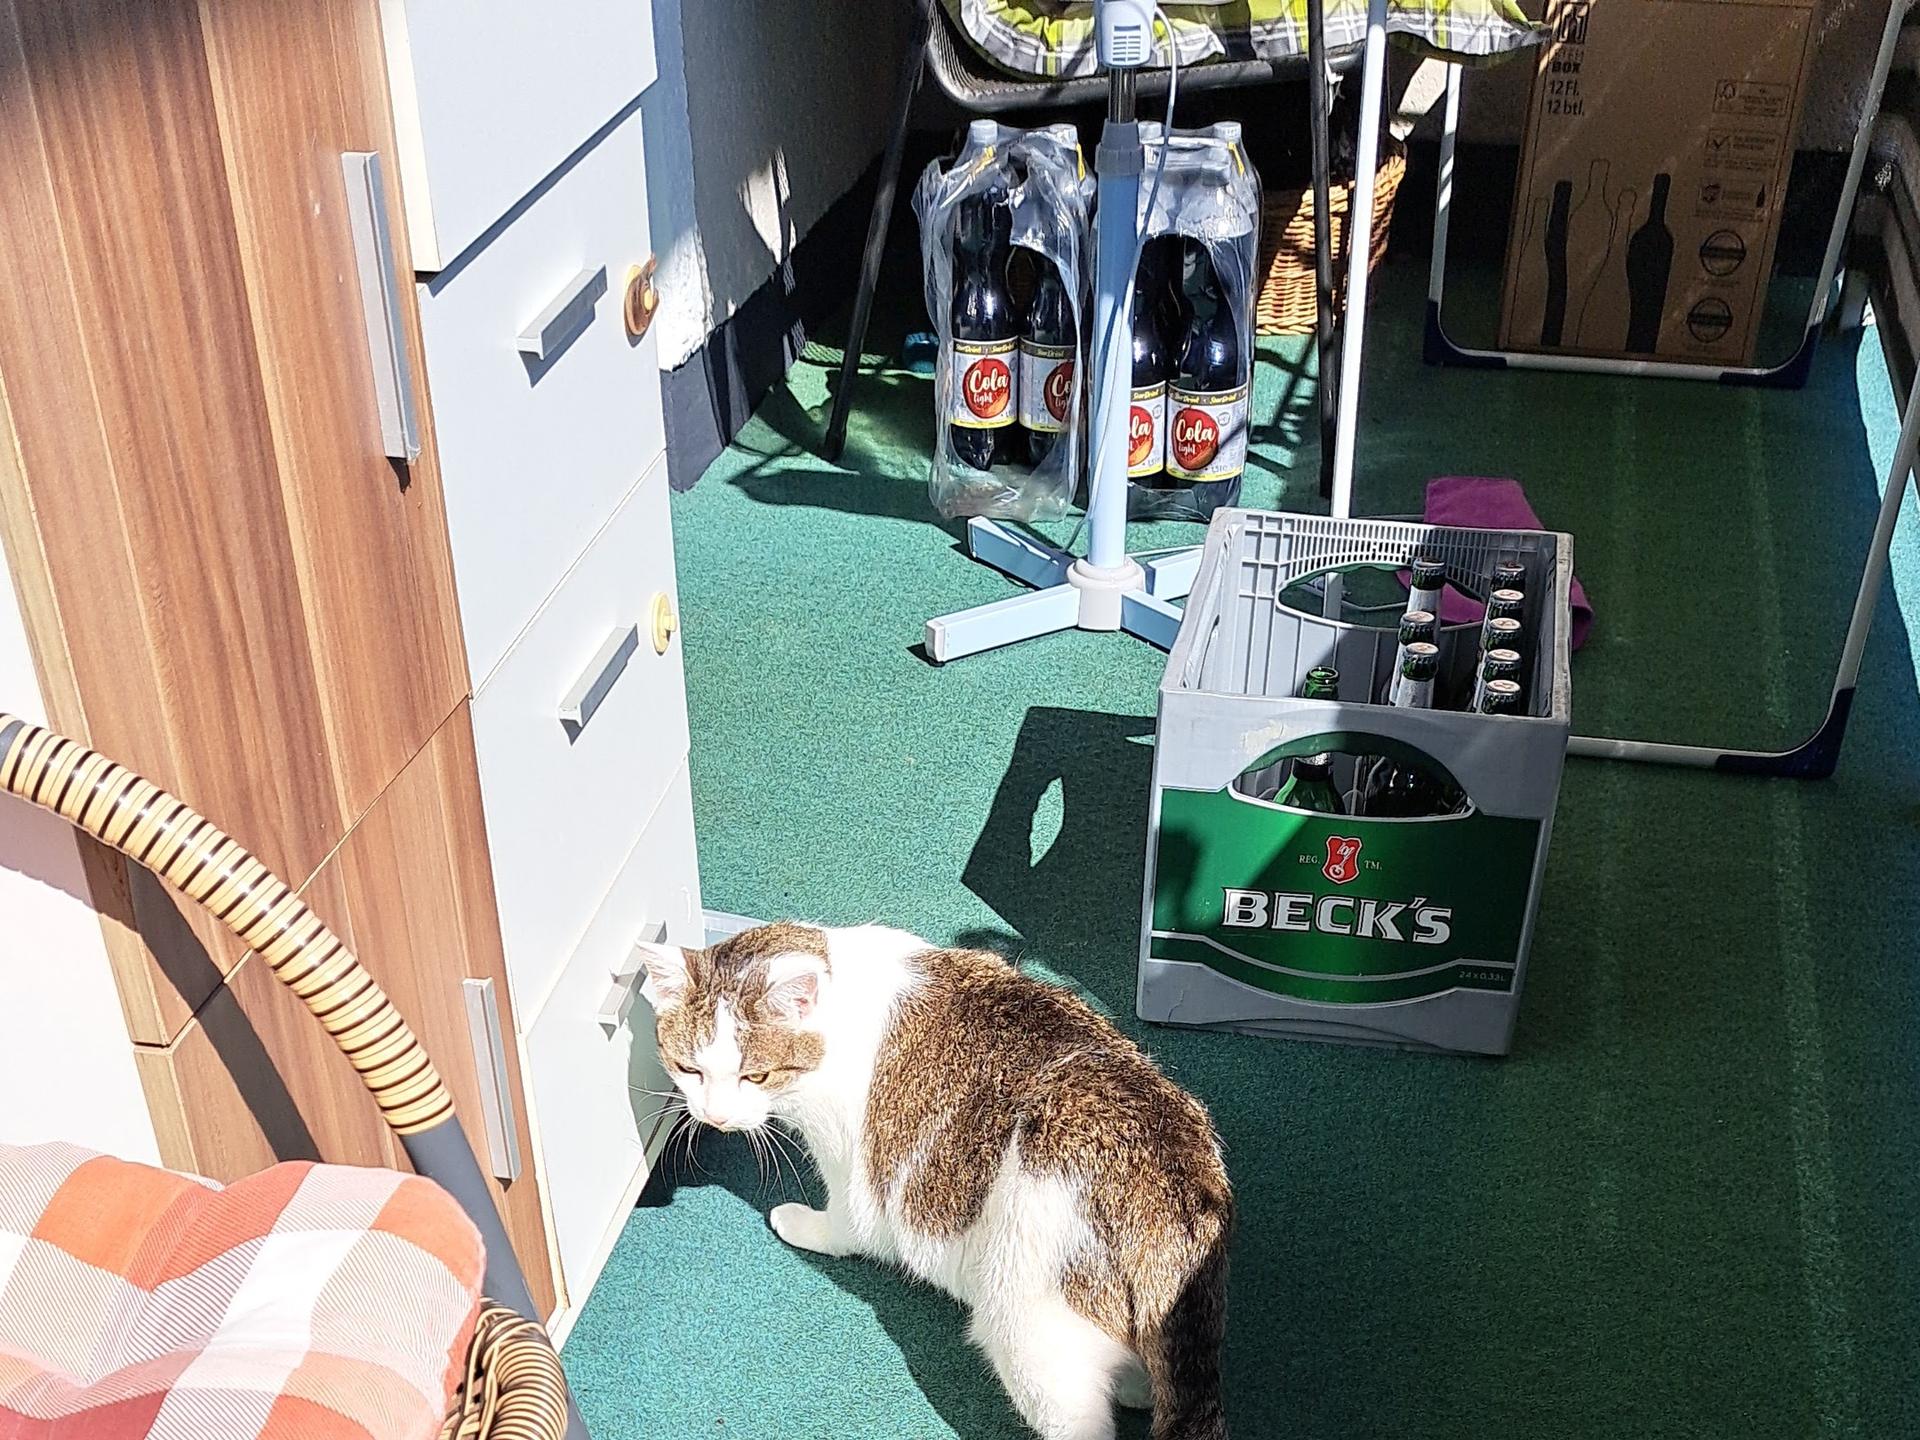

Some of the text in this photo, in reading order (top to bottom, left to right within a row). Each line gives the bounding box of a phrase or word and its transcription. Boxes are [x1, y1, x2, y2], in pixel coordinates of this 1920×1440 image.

[969, 368, 1008, 393] Cola
[1052, 374, 1071, 397] Co
[974, 392, 993, 406] light
[1131, 416, 1151, 439] la
[1176, 419, 1216, 443] Cola
[1178, 443, 1196, 456] light
[1299, 855, 1321, 865] REG.
[1364, 860, 1383, 871] TM.
